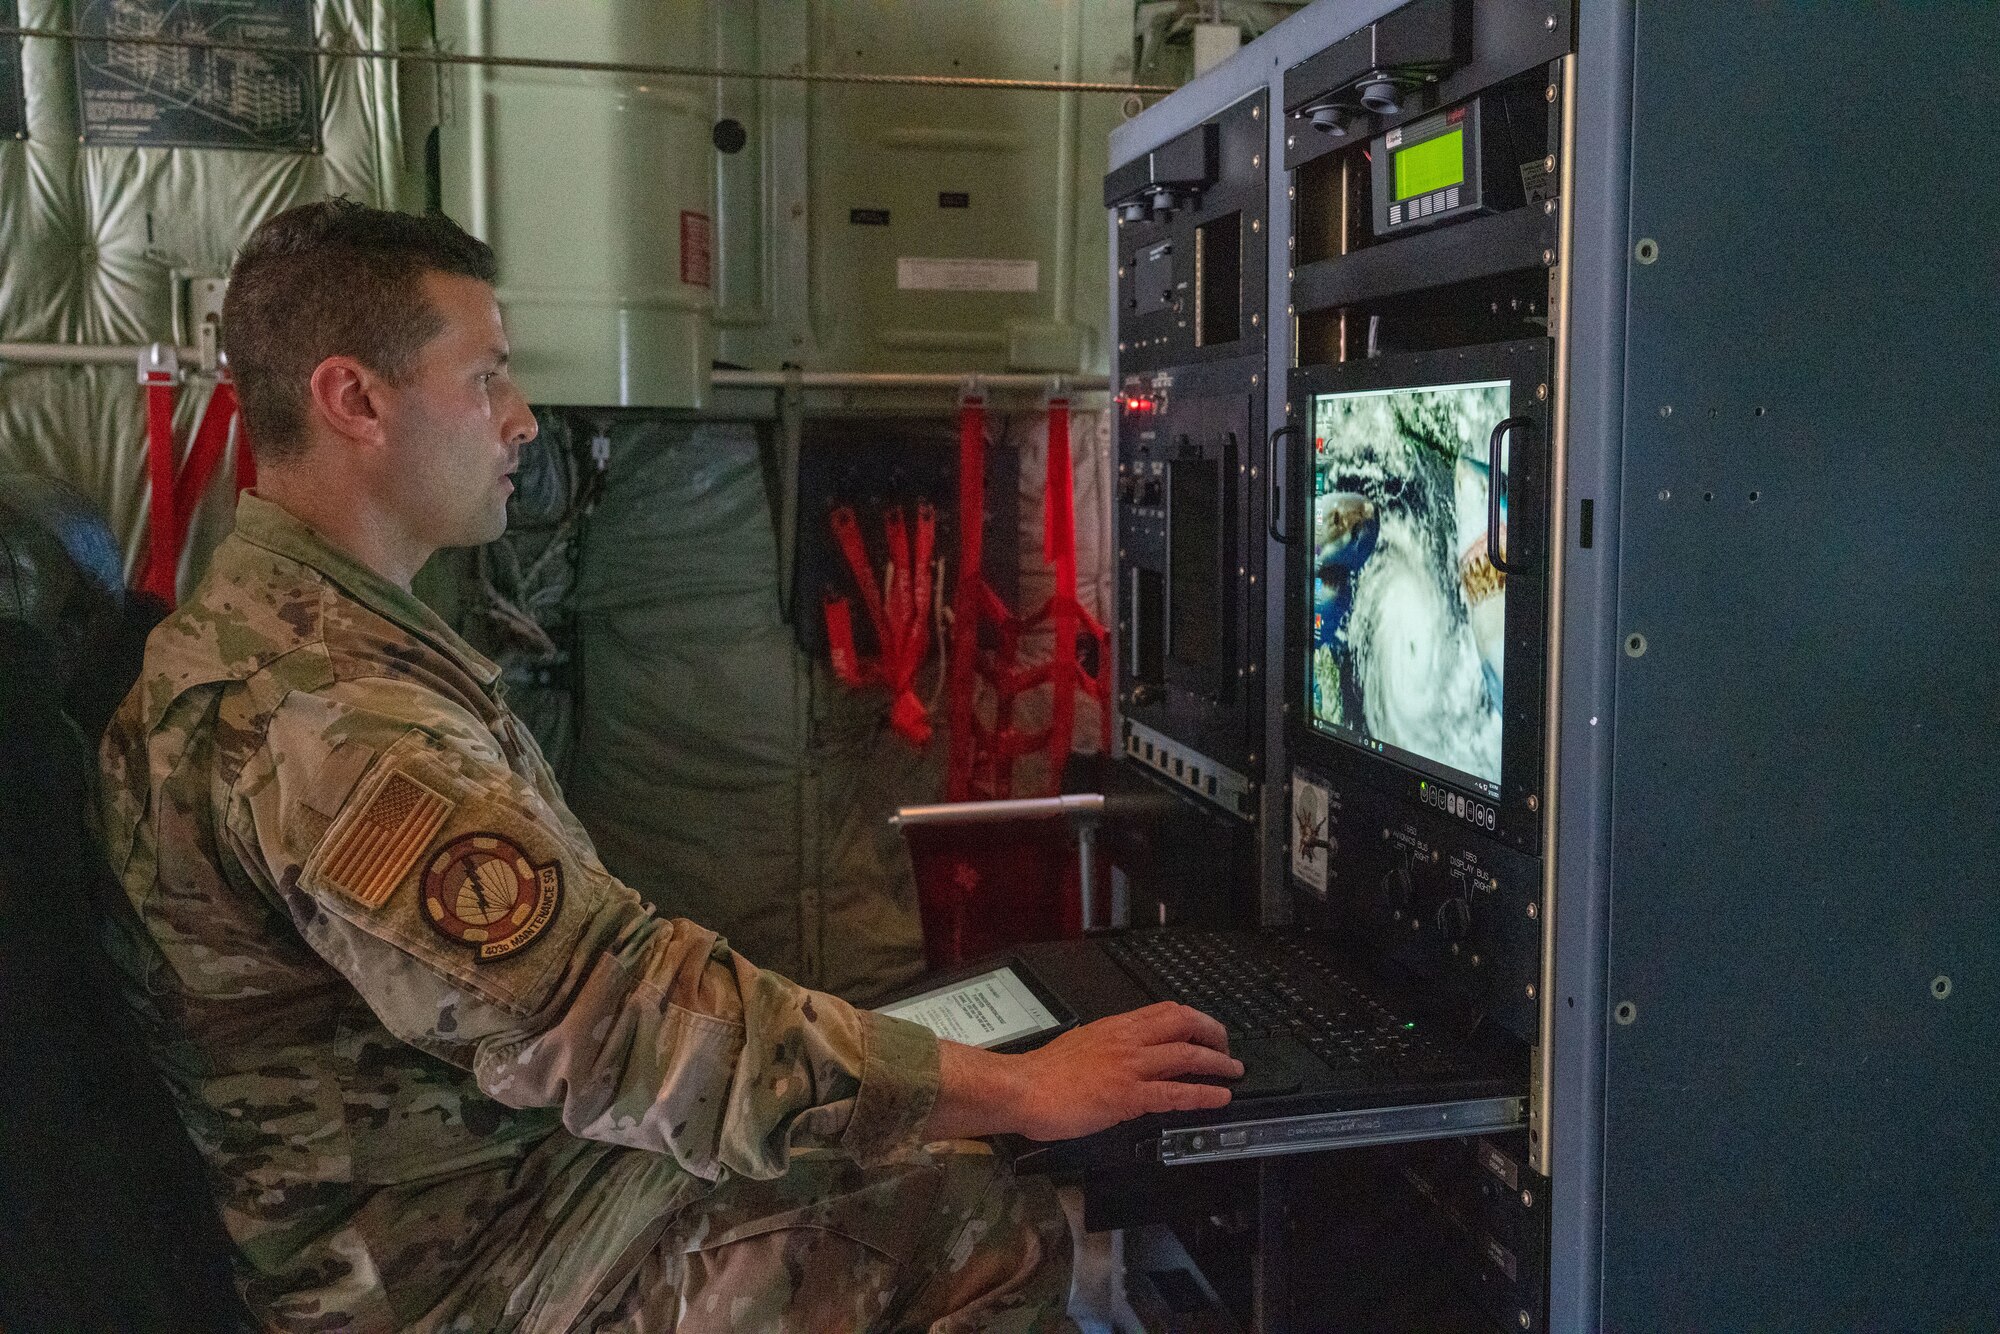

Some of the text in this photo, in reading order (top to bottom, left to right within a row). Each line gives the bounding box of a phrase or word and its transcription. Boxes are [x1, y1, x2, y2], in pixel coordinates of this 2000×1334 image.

[1450, 856, 1489, 881] DISPLAY BUS
[1463, 849, 1478, 864] 1553
[1450, 868, 1492, 894] LEFT RIGHT
[511, 886, 555, 947] MAINTENANCE
[543, 869, 555, 885] SQ
